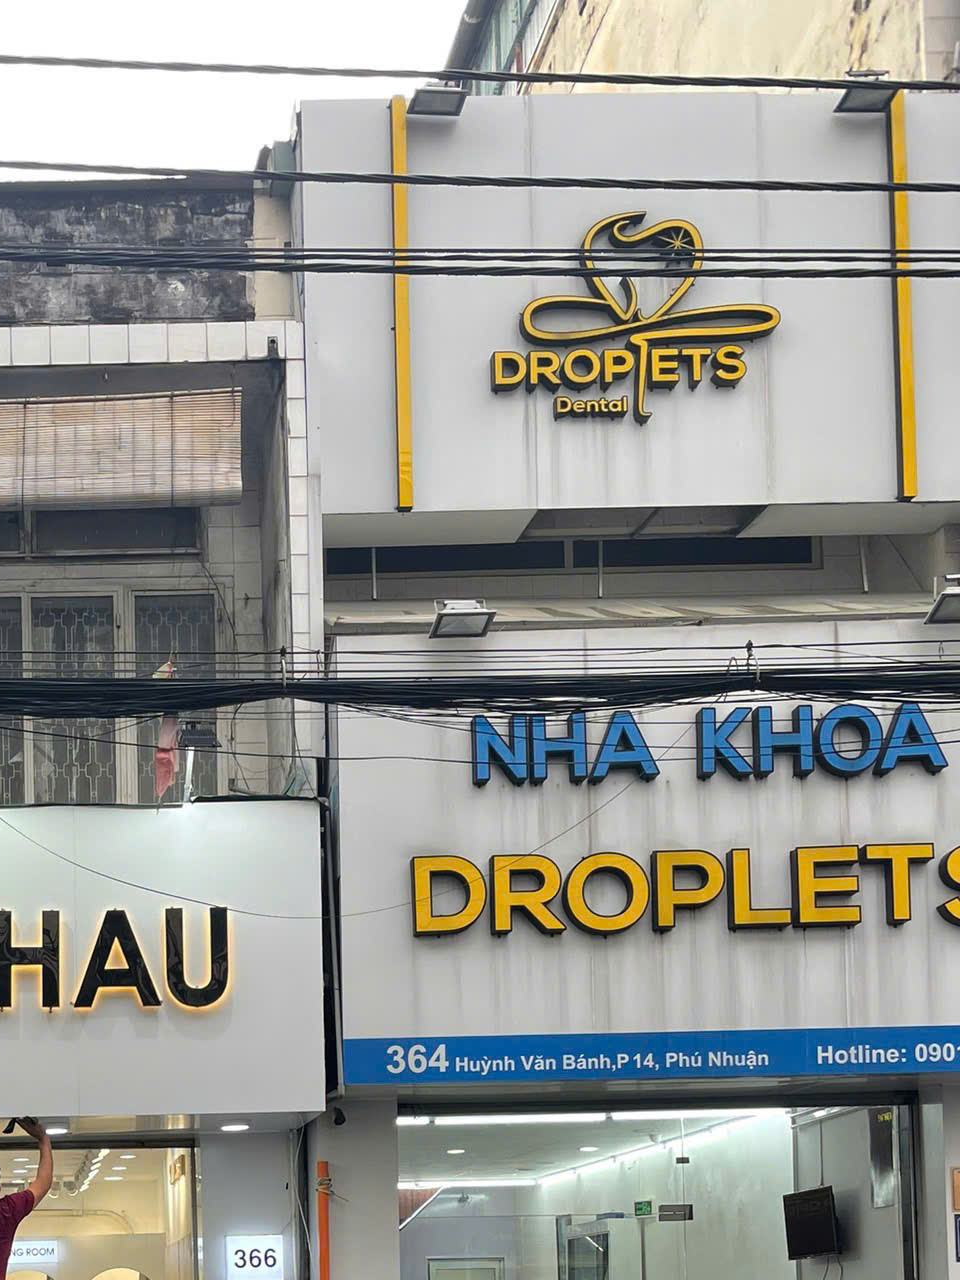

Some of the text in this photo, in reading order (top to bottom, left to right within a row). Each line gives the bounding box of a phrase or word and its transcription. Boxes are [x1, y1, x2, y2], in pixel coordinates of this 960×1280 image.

[490, 344, 748, 397] DROPLETS
[554, 395, 629, 420] Dental
[471, 701, 948, 785] NHA KHOA
[386, 1043, 449, 1074] 364
[455, 1055, 515, 1076] Huỳnh
[520, 1054, 557, 1071] Văn
[665, 1052, 702, 1068] Phú
[708, 1050, 769, 1070] Nhuận
[816, 1044, 908, 1065] Hotline:
[26, 1248, 55, 1257] ROOM
[234, 1248, 277, 1269] 366
